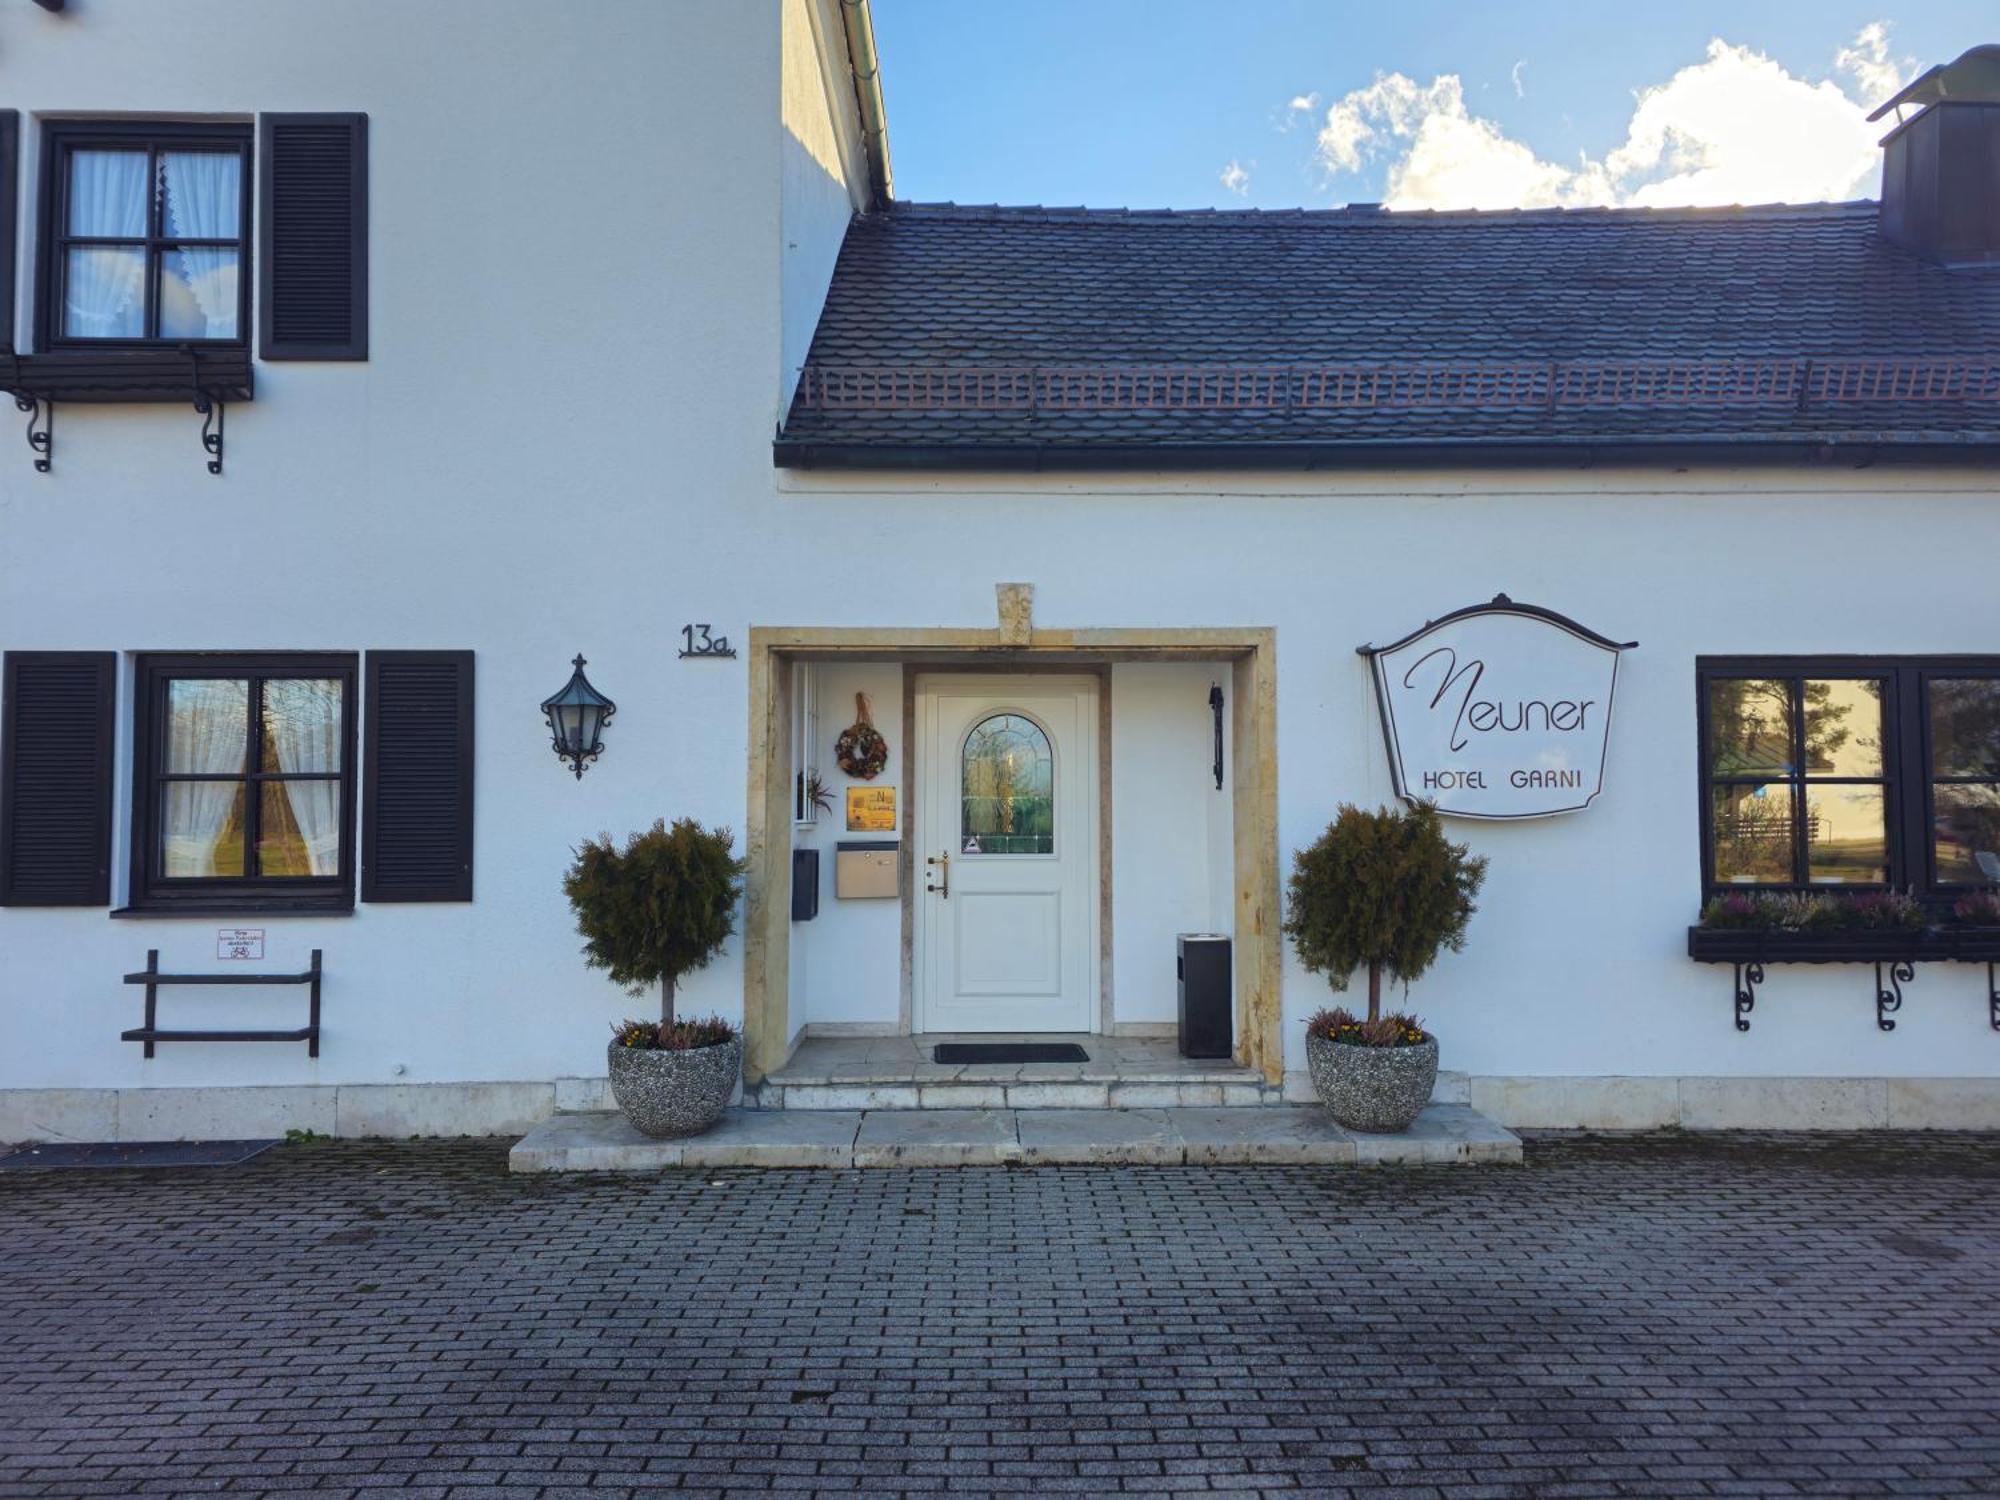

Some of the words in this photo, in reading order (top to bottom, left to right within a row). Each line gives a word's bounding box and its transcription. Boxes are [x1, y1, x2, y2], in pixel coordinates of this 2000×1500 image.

[682, 624, 728, 655] 13a
[1403, 646, 1595, 752] Neuner
[1423, 771, 1487, 789] HOTEL
[1510, 770, 1582, 788] GARNI
